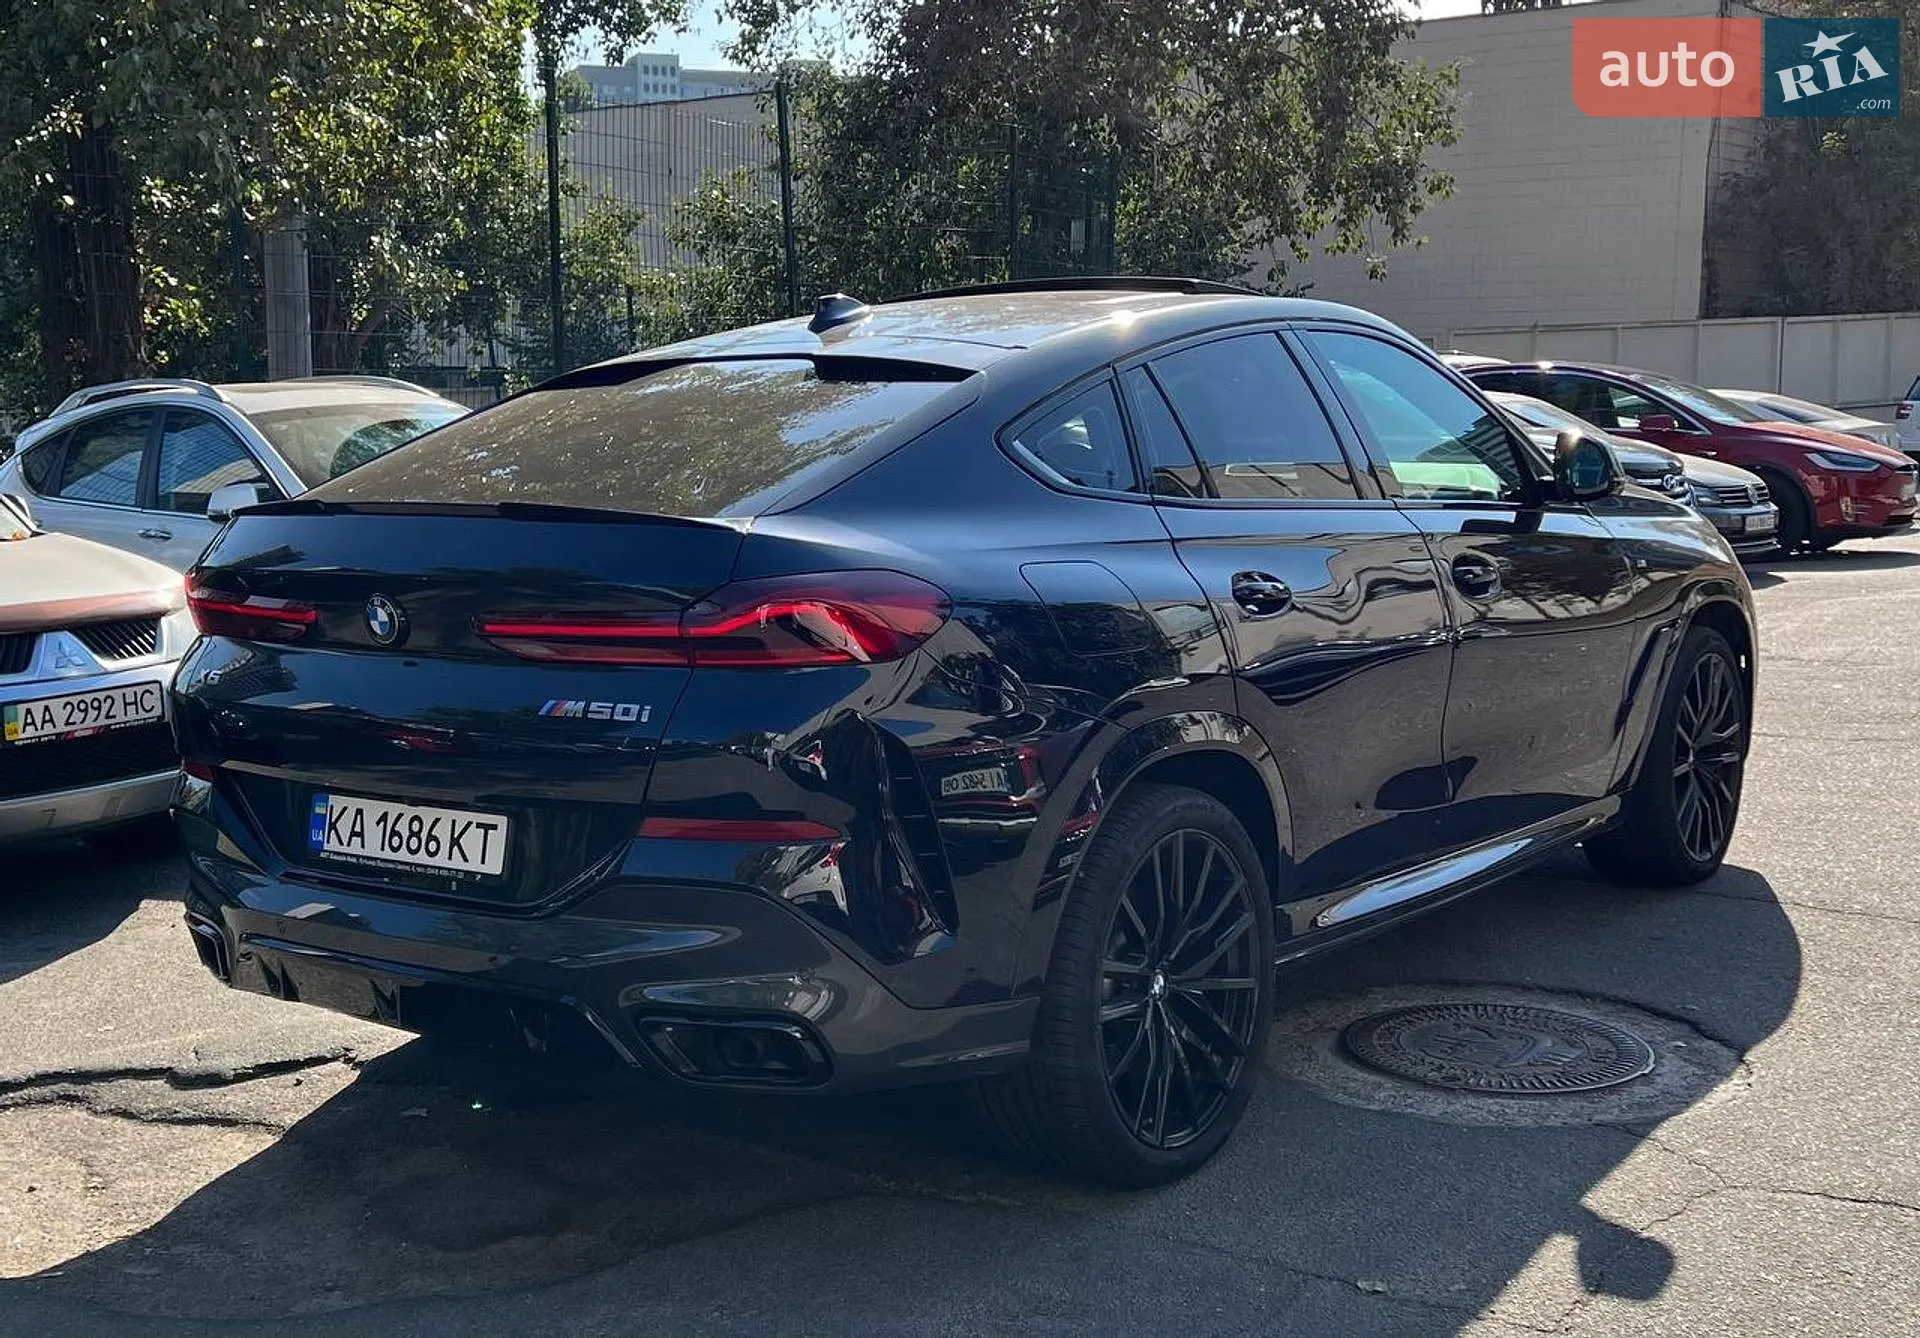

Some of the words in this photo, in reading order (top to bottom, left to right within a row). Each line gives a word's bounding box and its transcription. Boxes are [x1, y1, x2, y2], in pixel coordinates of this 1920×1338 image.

[22, 705, 57, 734] AA
[62, 695, 117, 726] 2992
[122, 689, 155, 717] HC
[558, 700, 652, 723] M50i
[311, 829, 324, 842] UA
[326, 804, 366, 849] KA
[375, 811, 441, 858] 1686
[447, 818, 498, 865] KT
